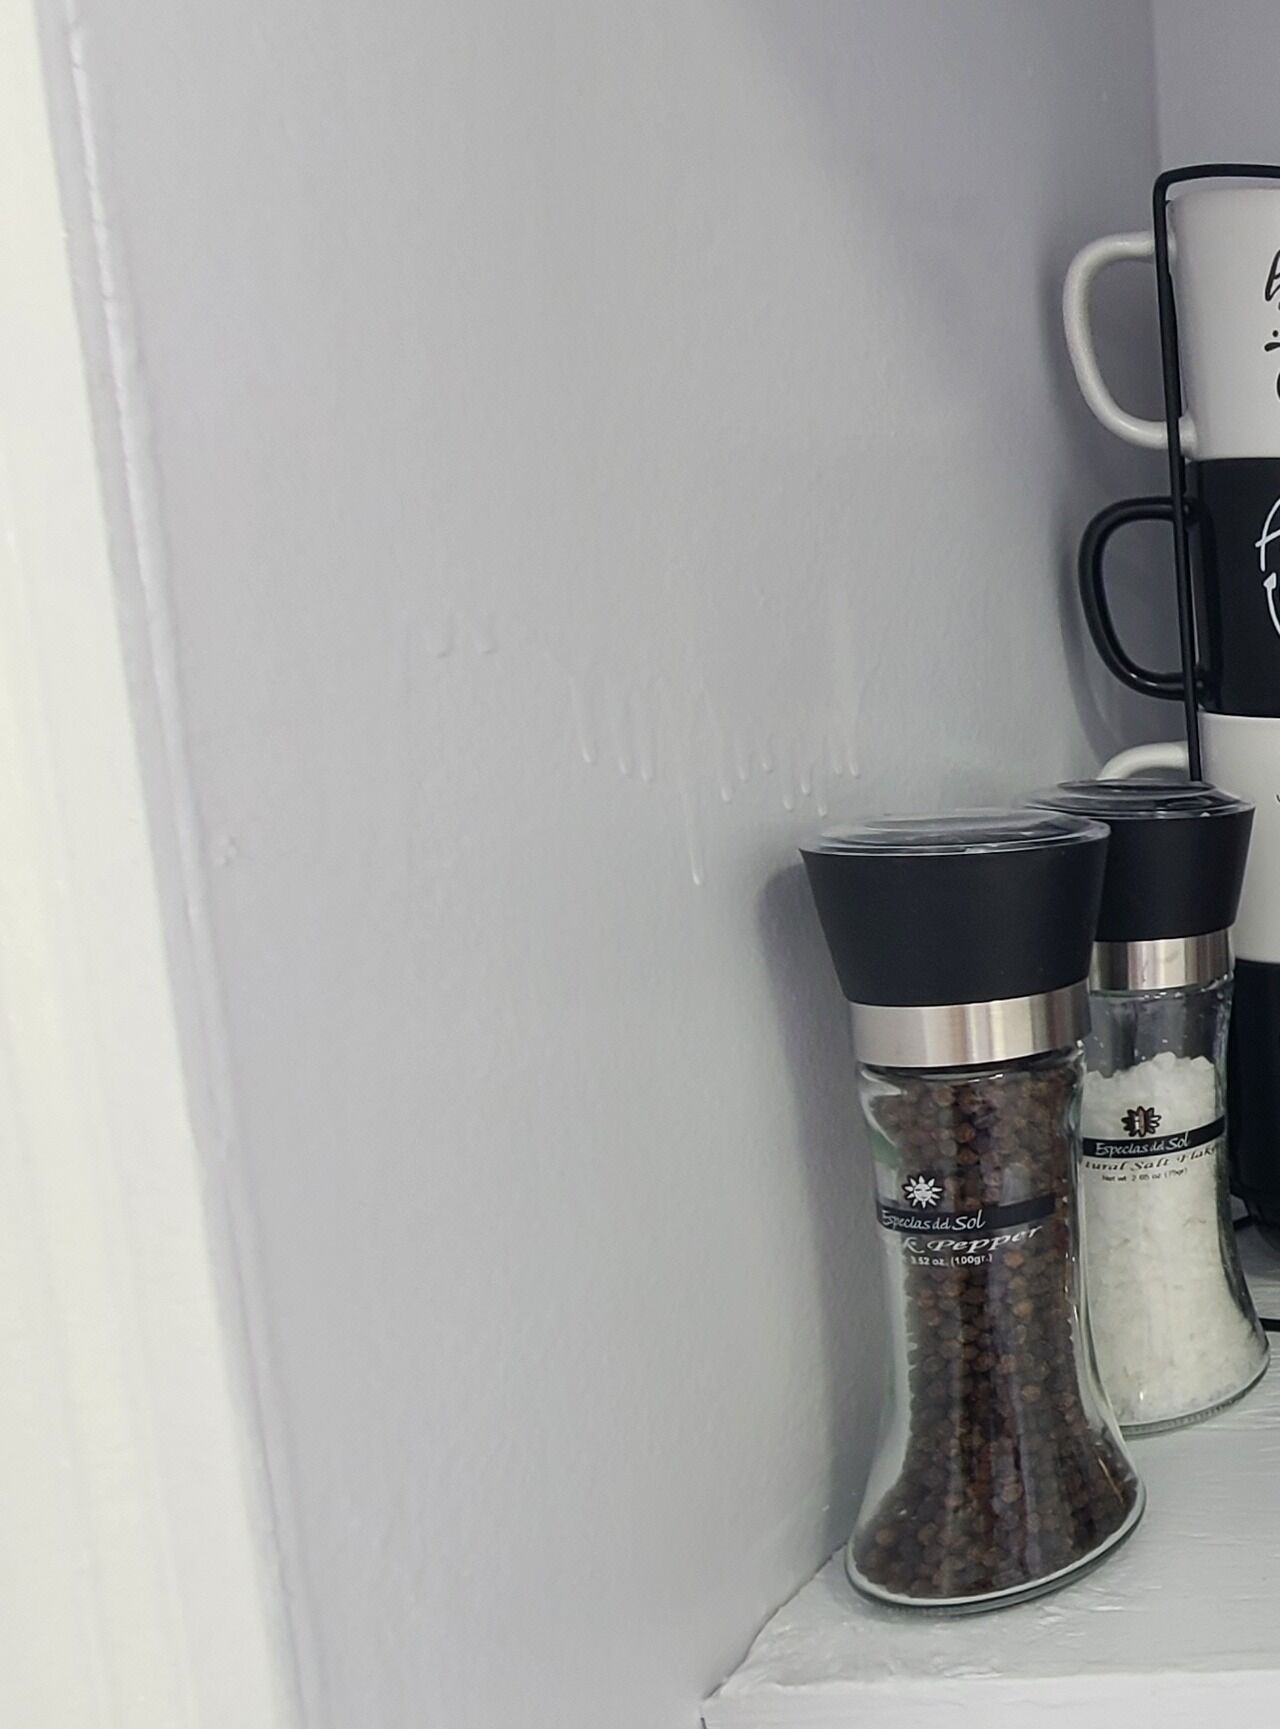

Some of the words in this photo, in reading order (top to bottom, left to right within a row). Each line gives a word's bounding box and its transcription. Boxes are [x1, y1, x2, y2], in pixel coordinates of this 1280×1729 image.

[1165, 1130, 1190, 1151] Sol
[951, 1209, 986, 1231] Sol
[927, 1226, 1042, 1254] Pepper
